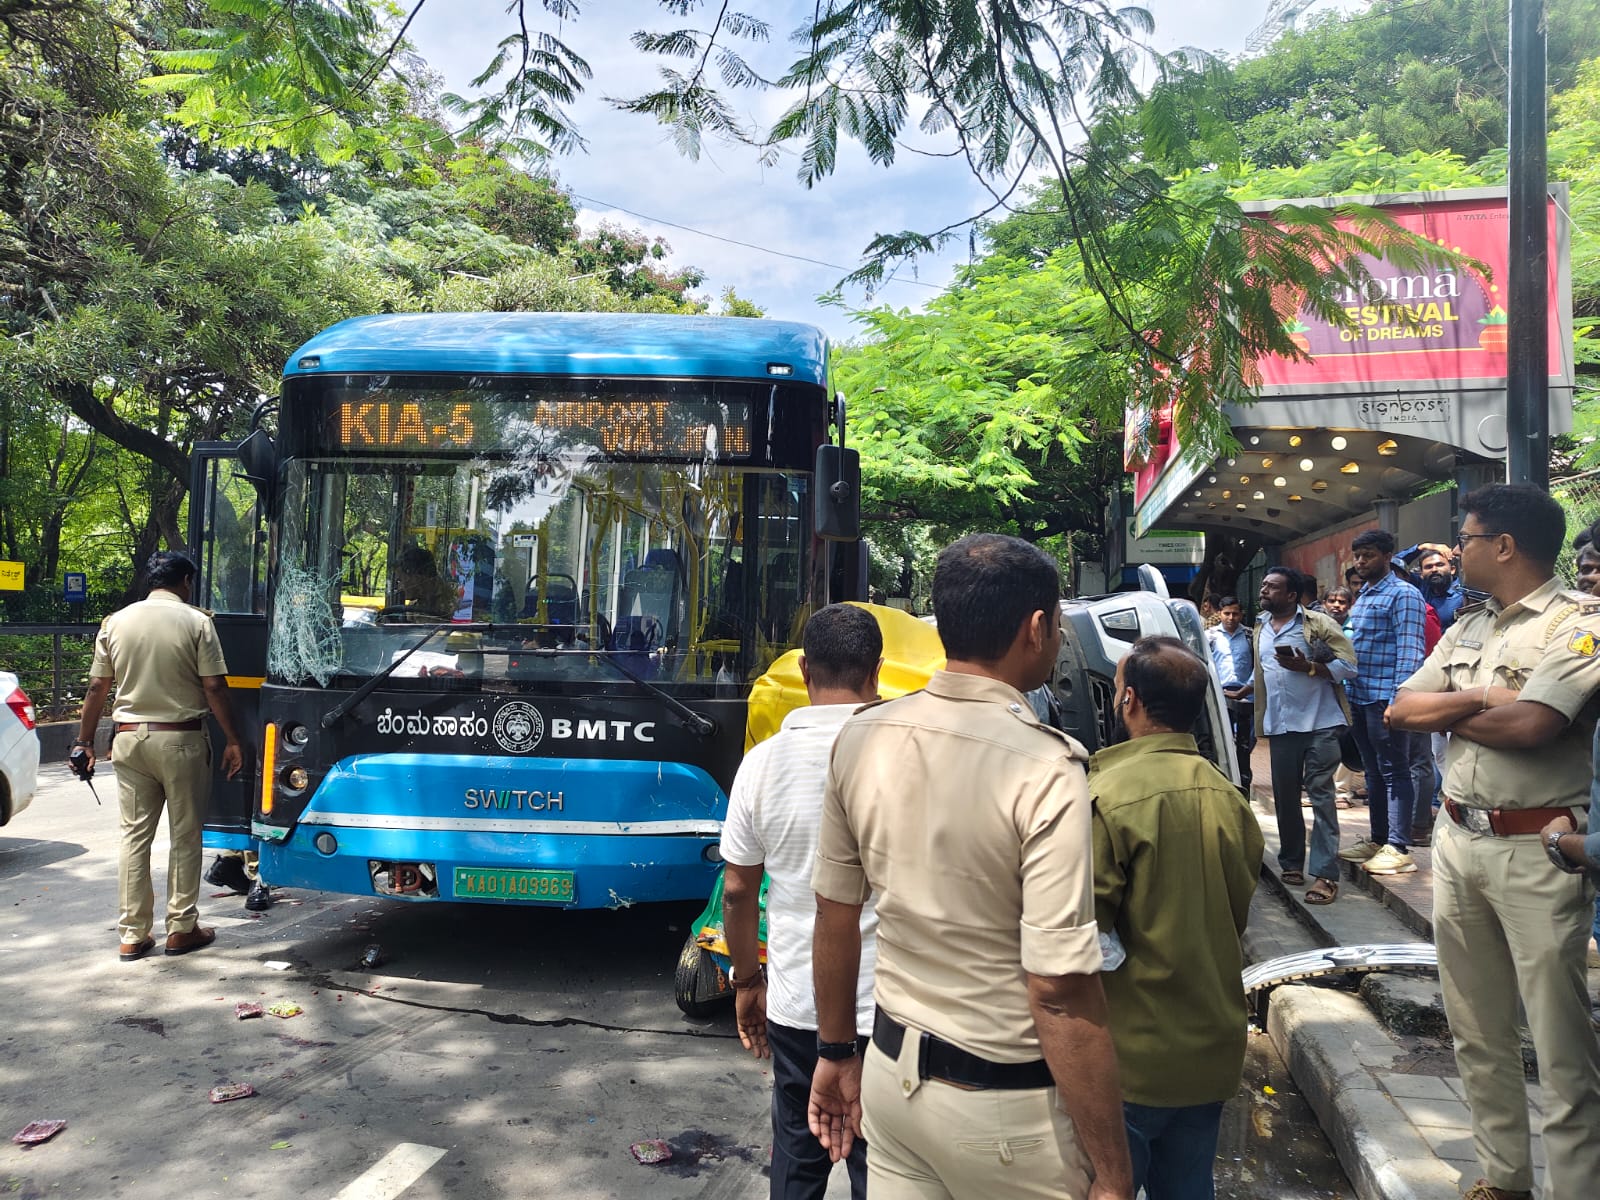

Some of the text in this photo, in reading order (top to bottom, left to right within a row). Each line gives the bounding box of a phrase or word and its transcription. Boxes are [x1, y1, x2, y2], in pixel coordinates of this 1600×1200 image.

[1463, 213, 1488, 221] TATA
[1328, 301, 1460, 327] ESTIVAL
[1339, 324, 1444, 342] OF DREAMS
[341, 401, 670, 444] KIA-5 AIRPORT
[551, 718, 656, 743] BMTC
